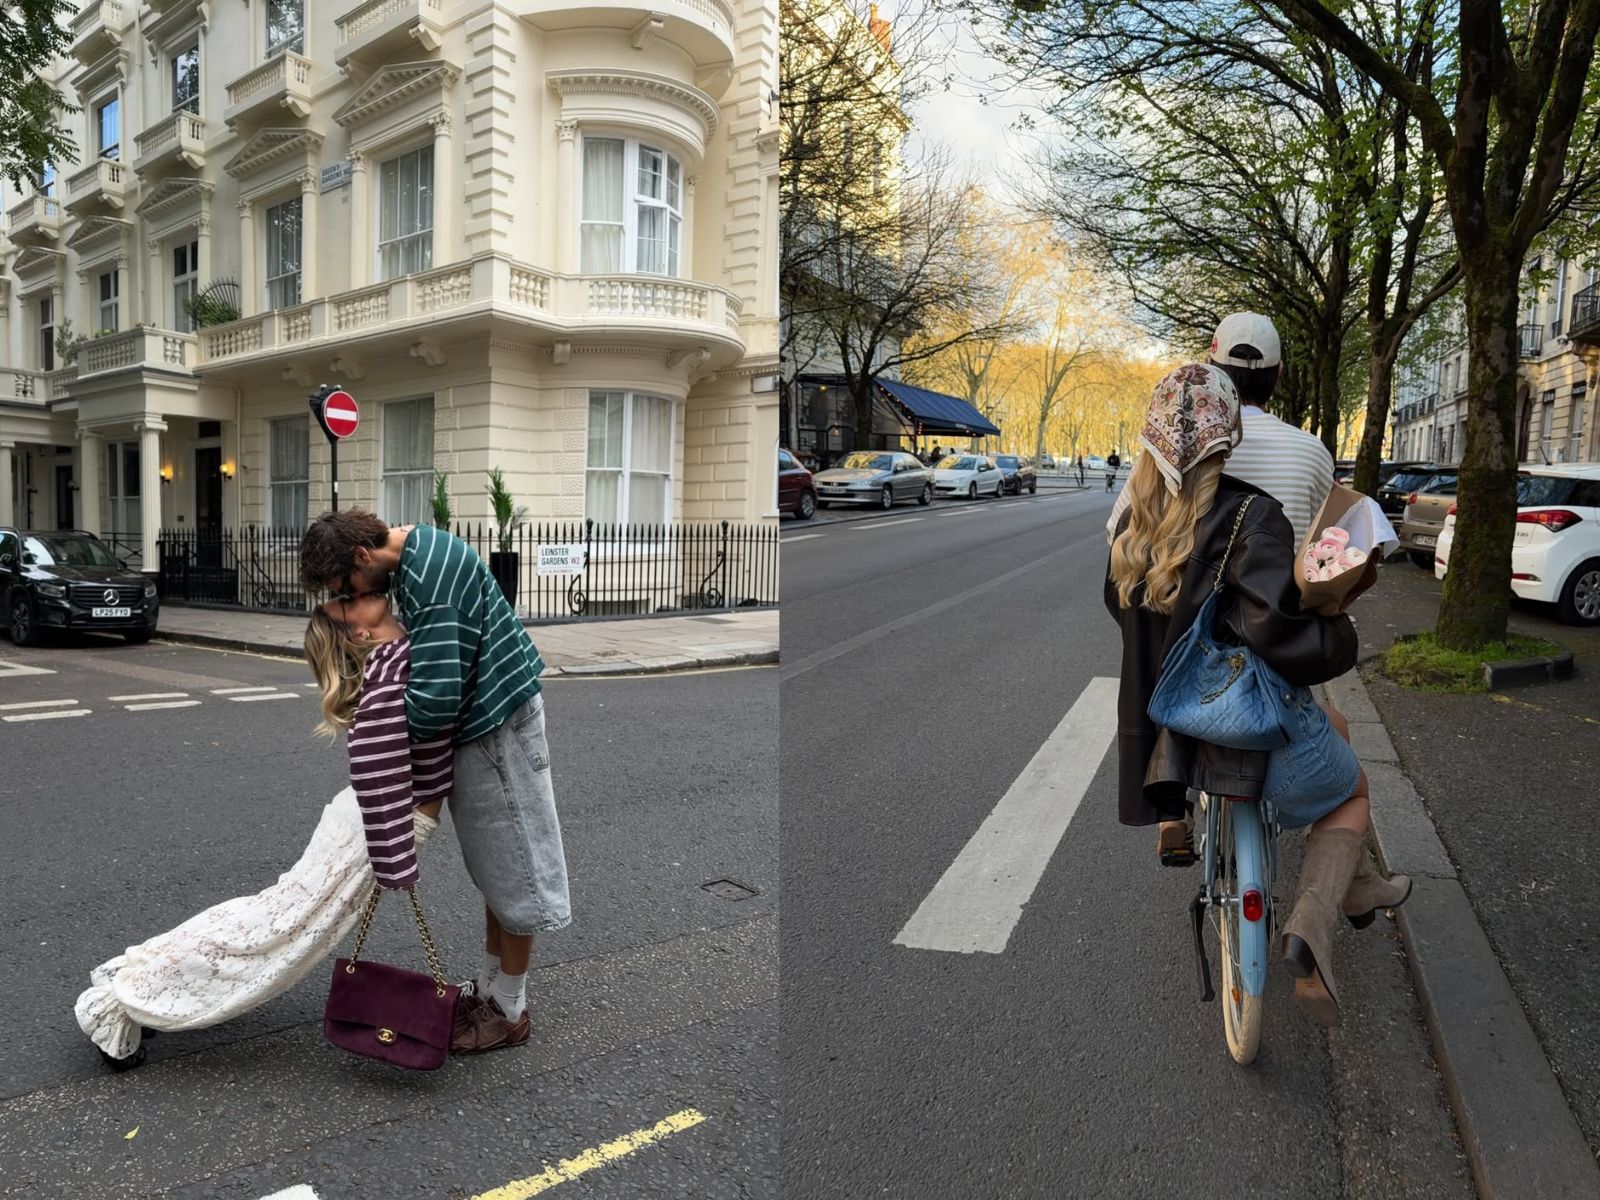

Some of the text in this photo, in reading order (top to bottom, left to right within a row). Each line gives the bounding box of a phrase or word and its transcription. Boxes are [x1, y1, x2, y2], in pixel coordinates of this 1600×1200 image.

[541, 547, 569, 556] LEINSTER
[541, 557, 580, 565] GARDENS W2
